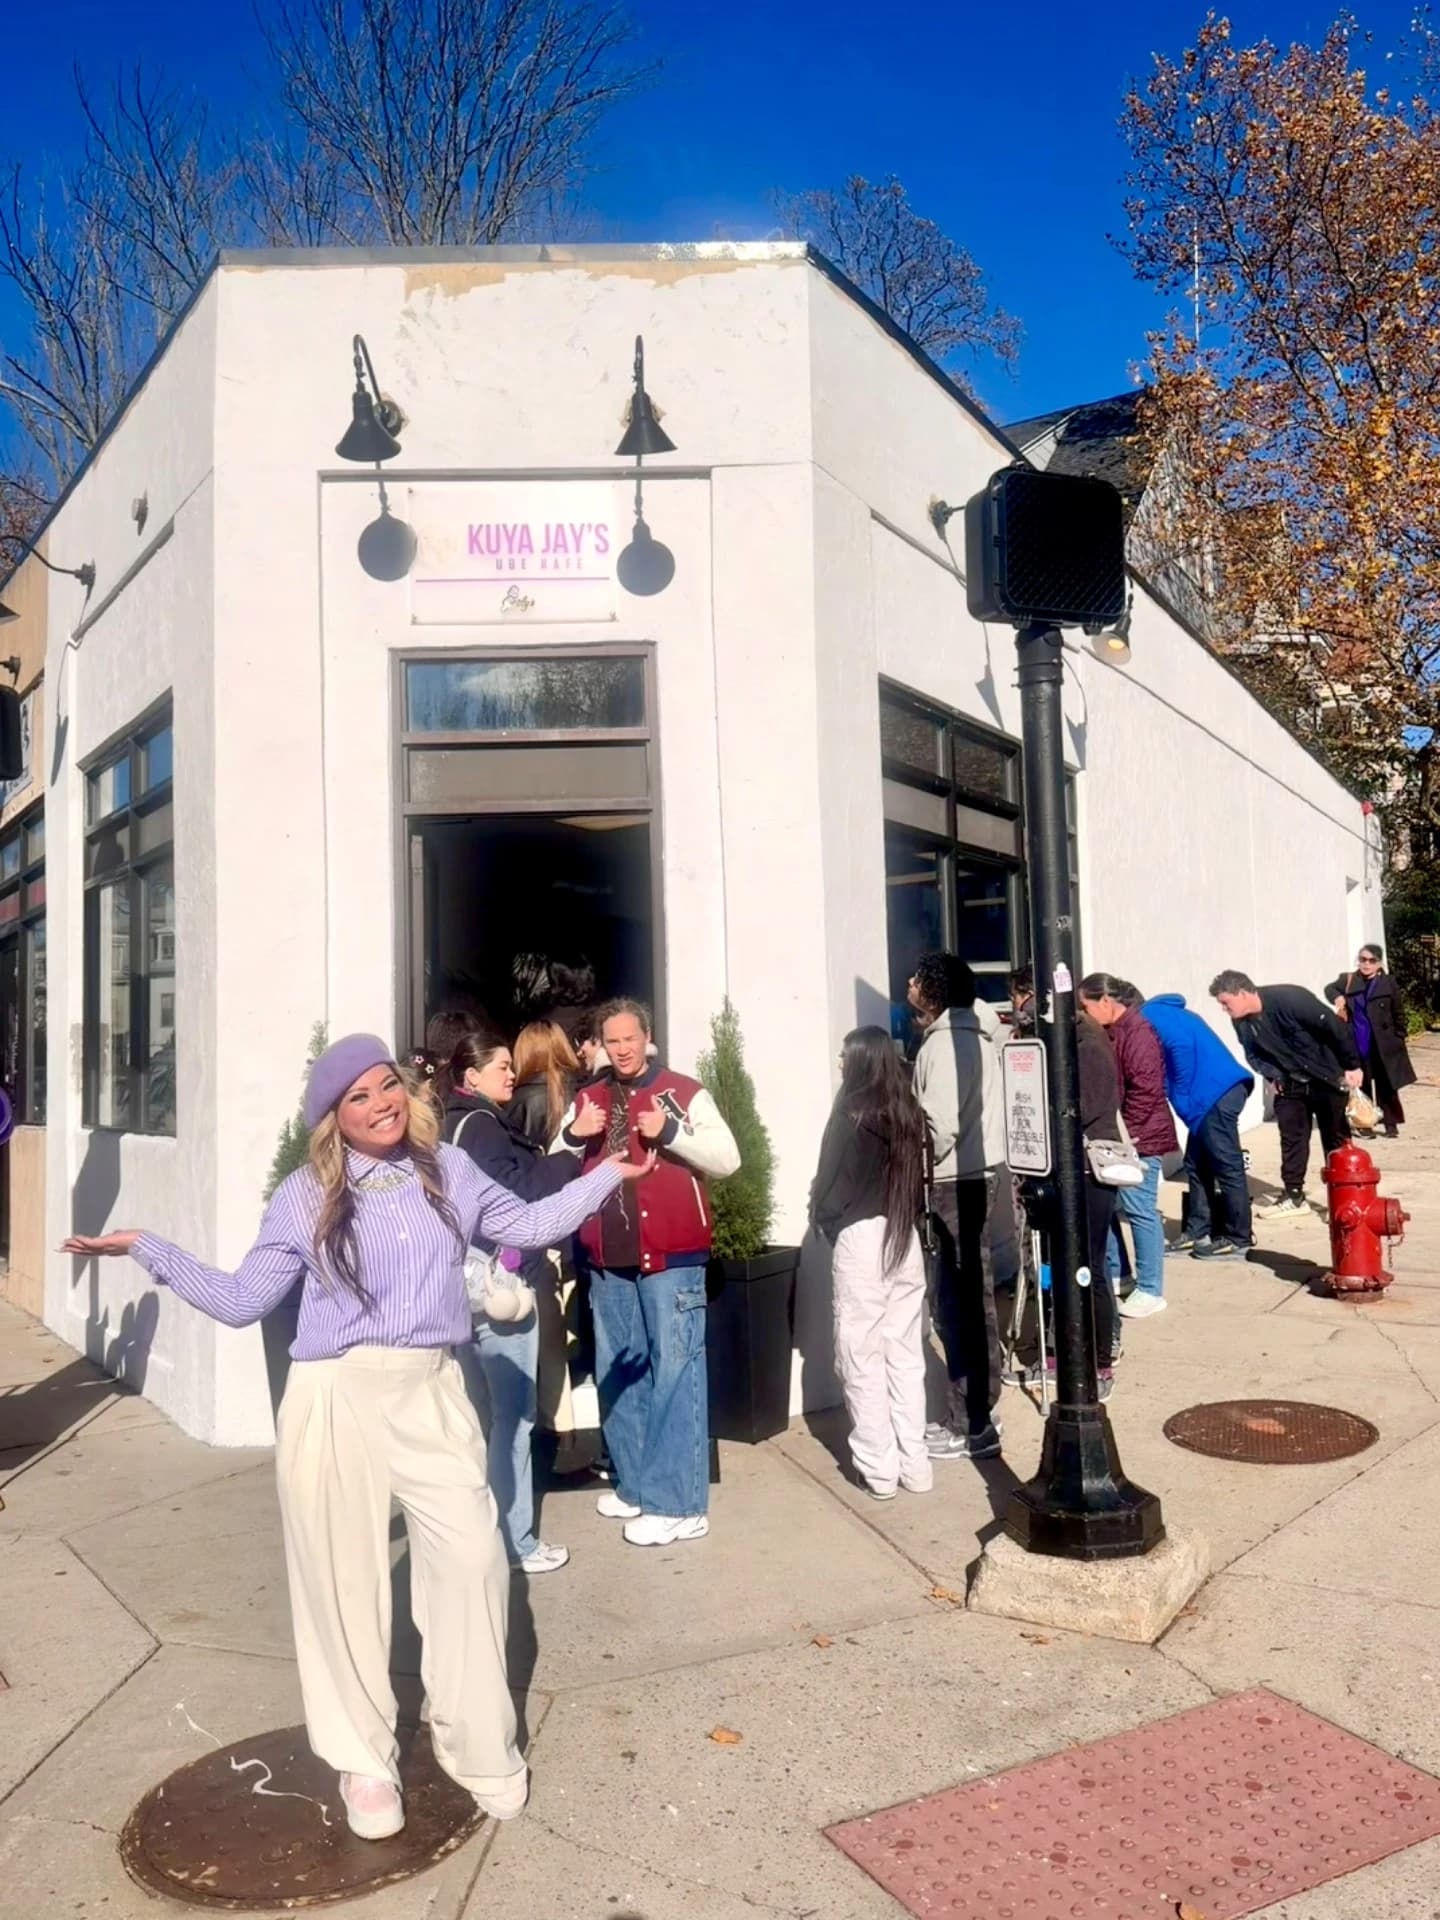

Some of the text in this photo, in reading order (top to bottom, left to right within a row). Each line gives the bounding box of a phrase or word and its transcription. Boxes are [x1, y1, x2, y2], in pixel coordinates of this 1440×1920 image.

[468, 522, 610, 555] KUYA JAY'S
[495, 558, 583, 571] UBE KAFE
